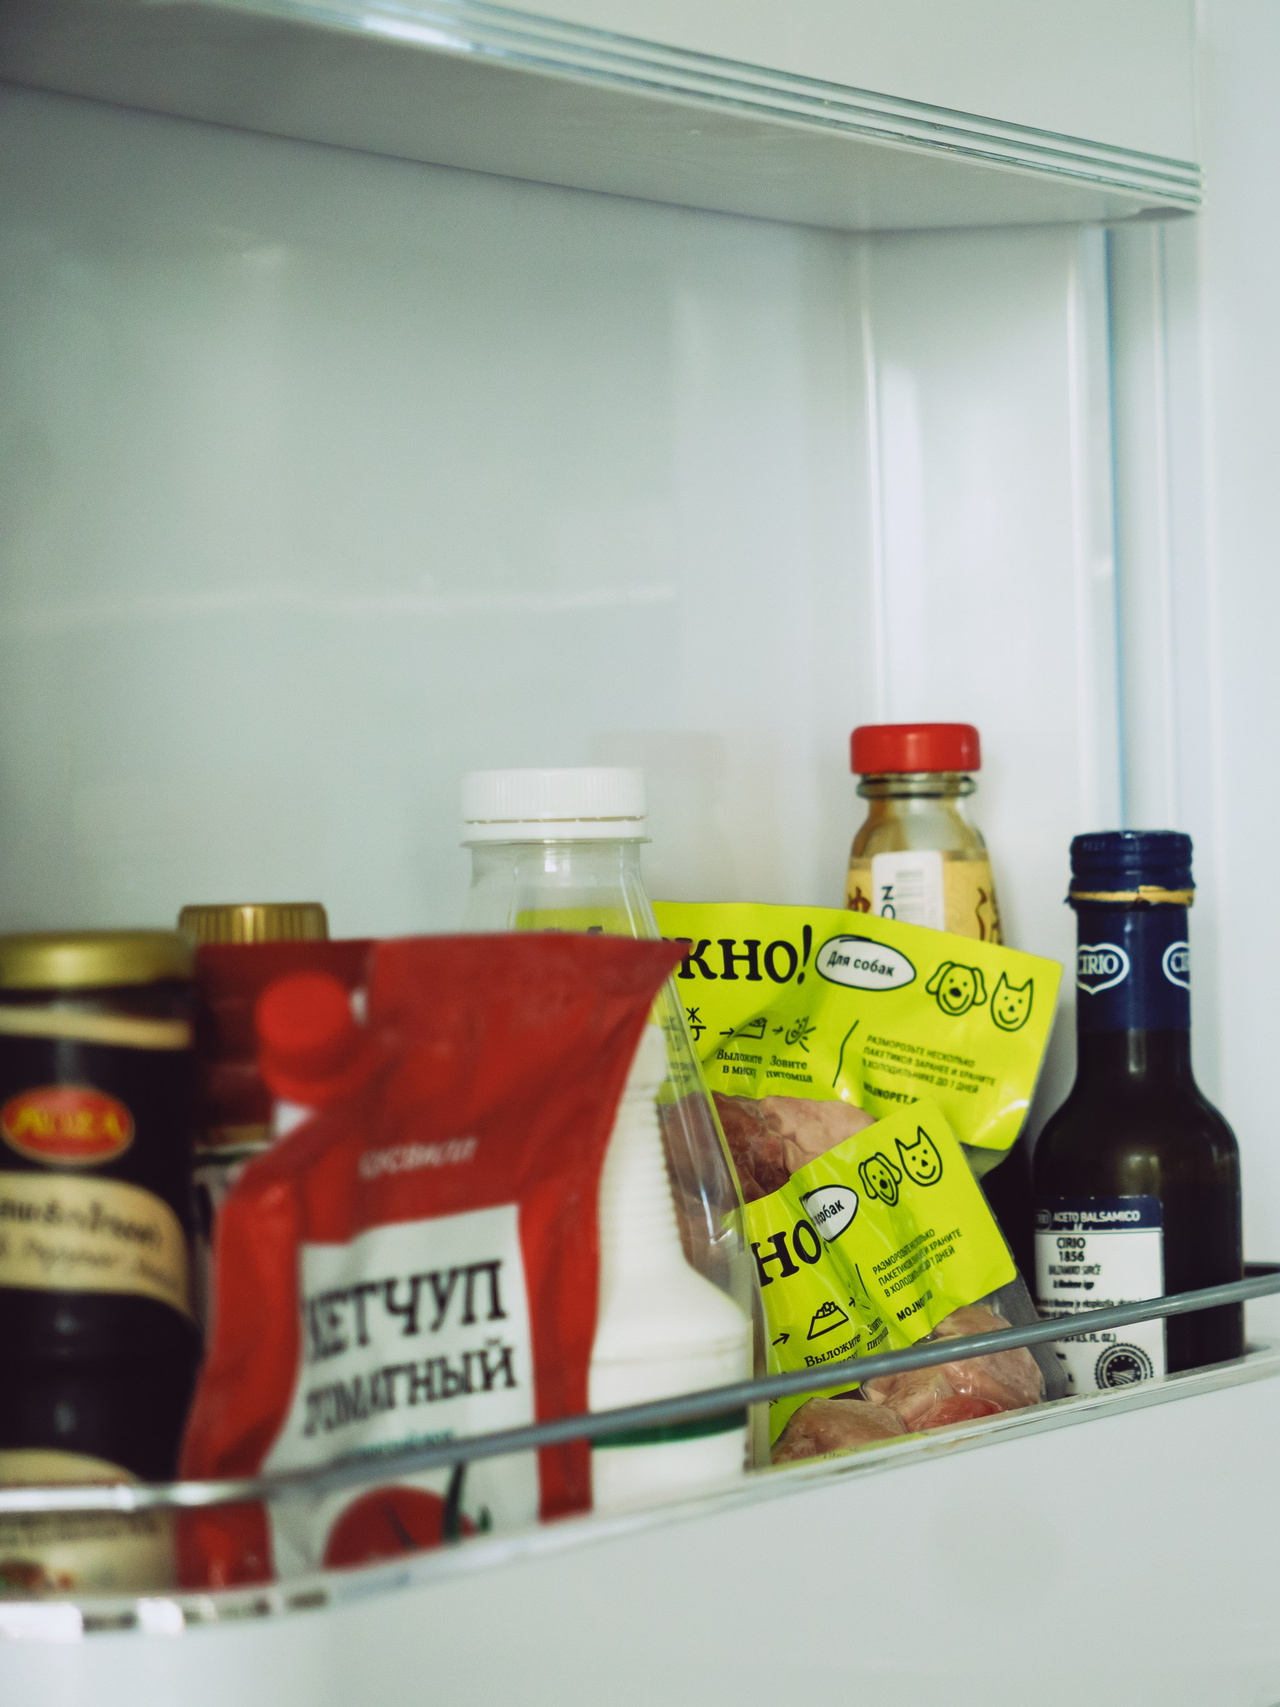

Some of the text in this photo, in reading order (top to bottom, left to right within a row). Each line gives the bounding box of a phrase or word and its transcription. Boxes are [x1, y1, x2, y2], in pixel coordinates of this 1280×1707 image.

[826, 950, 894, 977] Для собак
[770, 1055, 808, 1071] Зовите
[1053, 1212, 1079, 1223] ACETO
[1080, 1210, 1141, 1223] BALSAMICO
[929, 1228, 962, 1251] ХРАНИТЕ
[1056, 1237, 1086, 1249] CIRIO
[934, 1244, 956, 1265] ДНЕЙ
[1058, 1251, 1085, 1262] 1856
[304, 1258, 508, 1364] ЕТЧУП
[803, 1333, 861, 1367] Выложите
